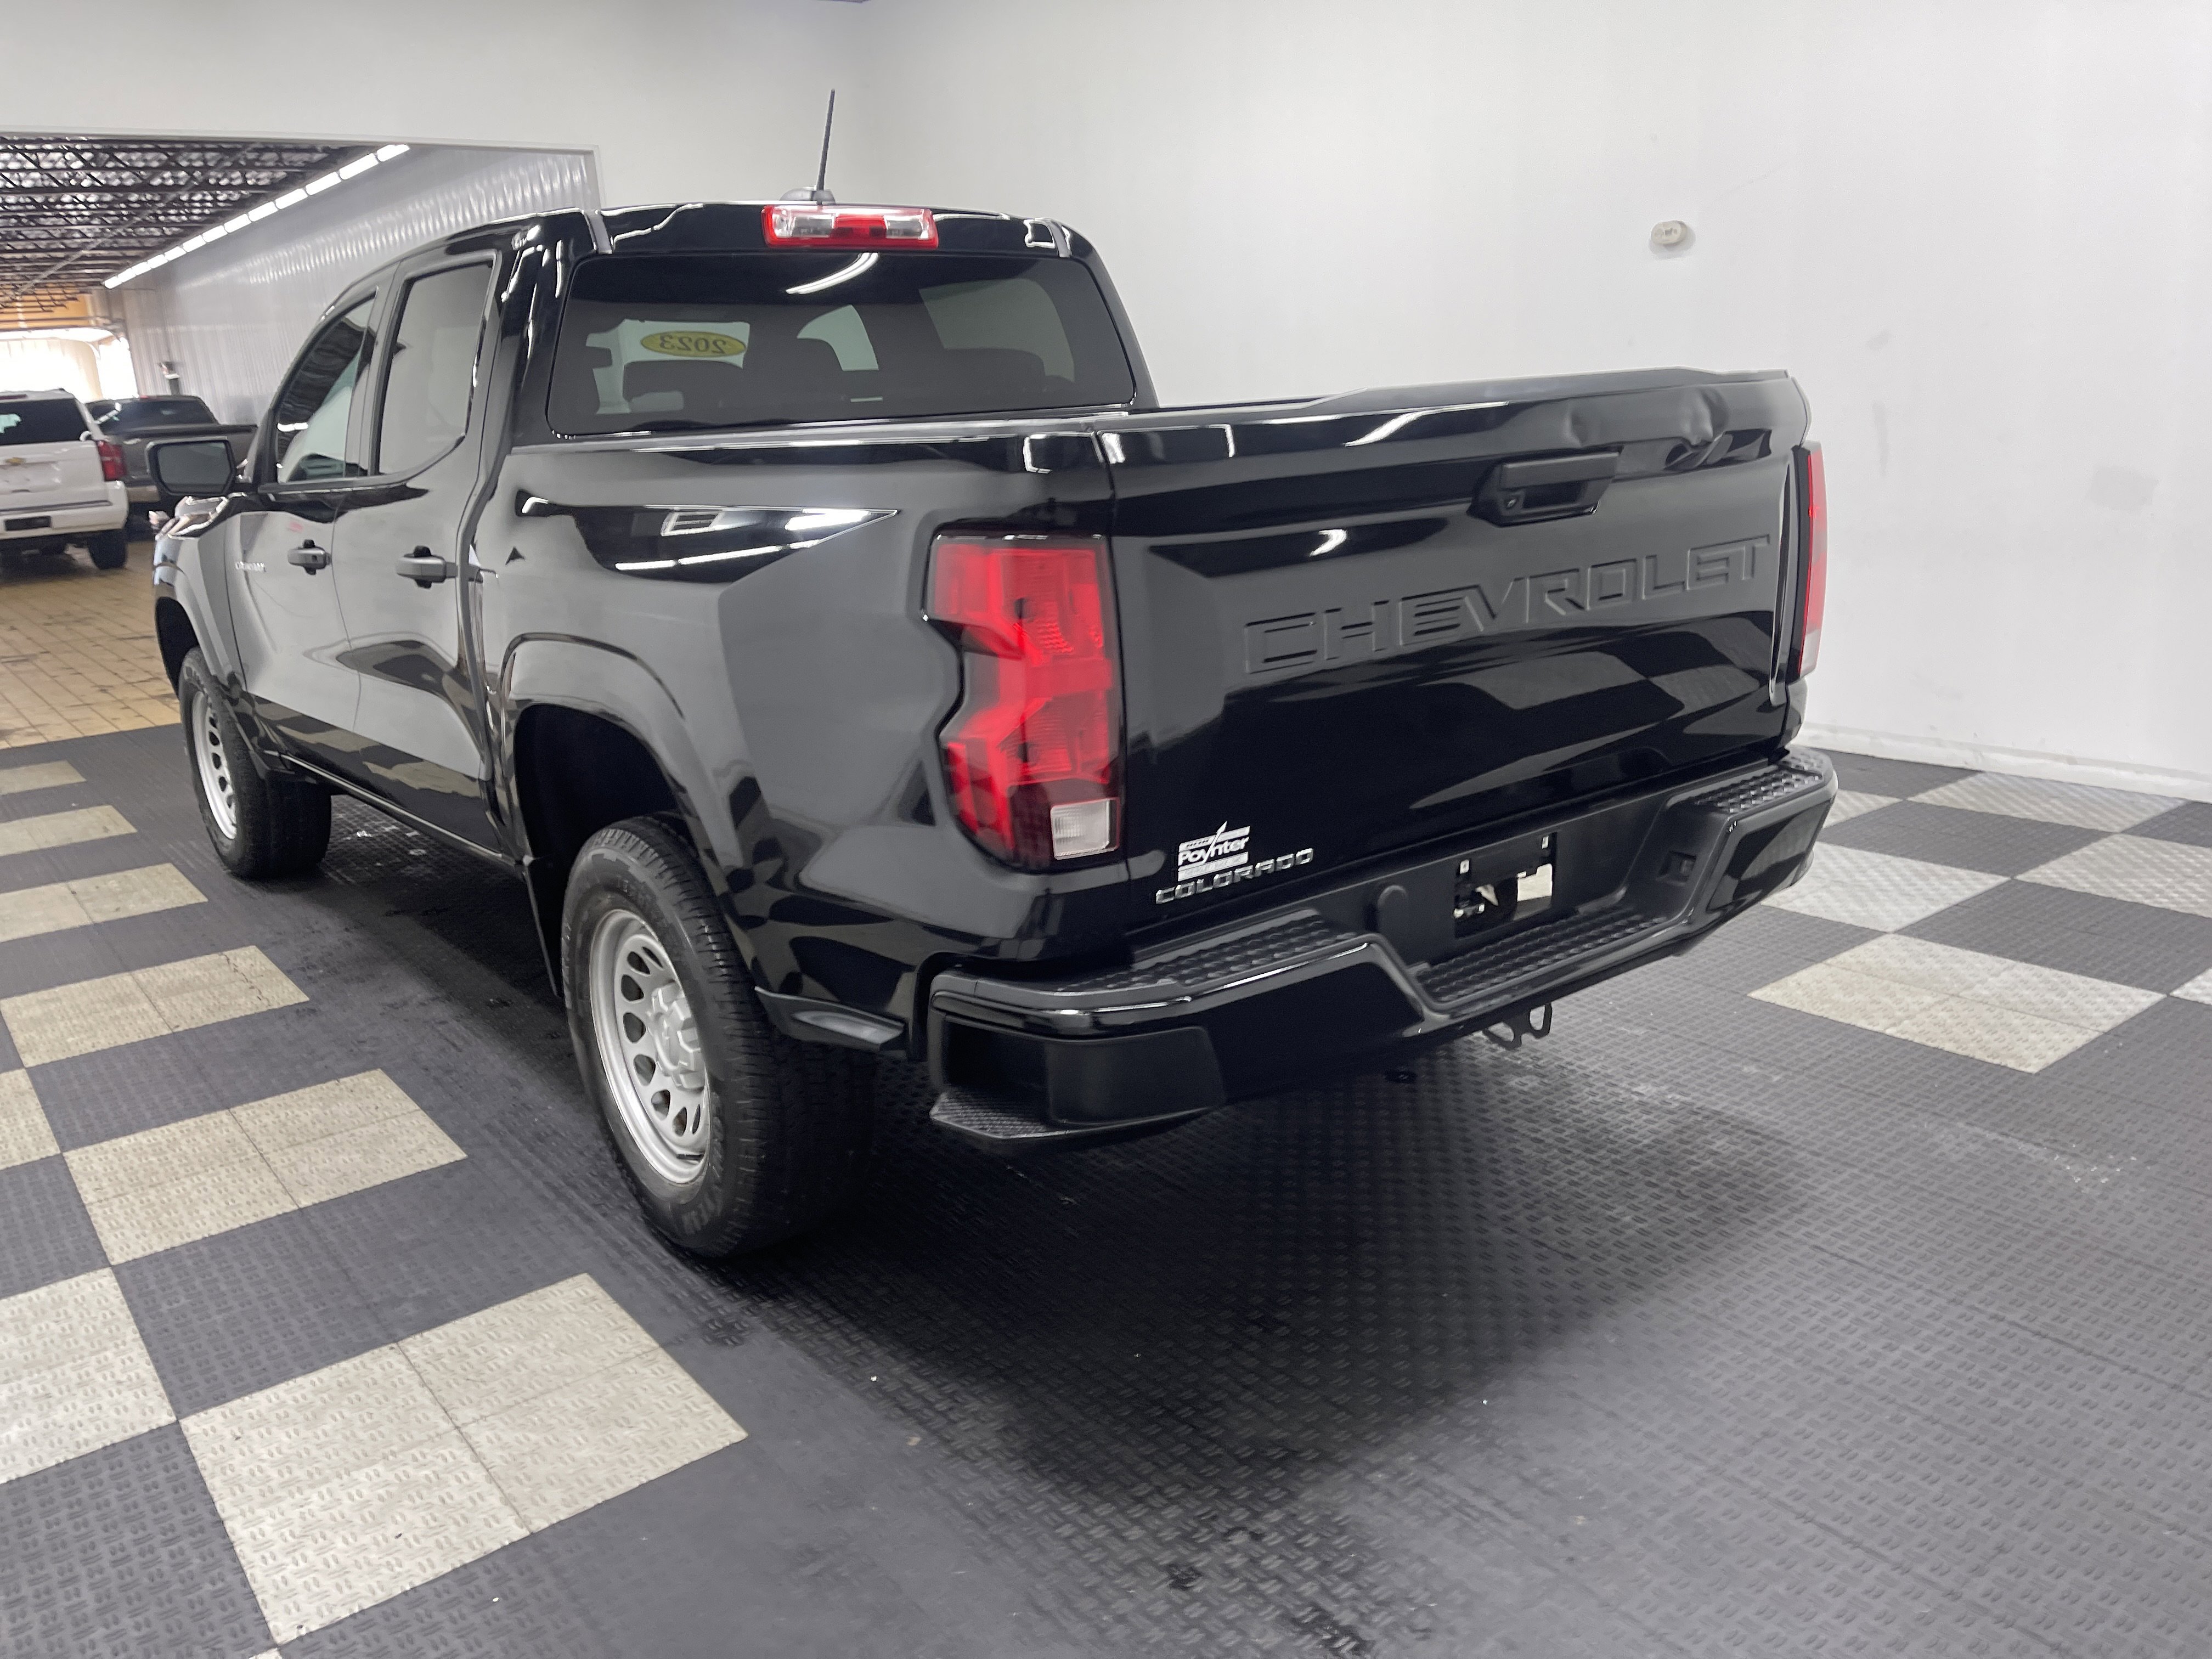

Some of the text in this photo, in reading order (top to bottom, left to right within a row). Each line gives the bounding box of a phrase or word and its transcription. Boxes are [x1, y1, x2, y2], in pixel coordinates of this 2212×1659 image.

[1243, 533, 1771, 673] CHEVROLET
[1155, 848, 1314, 904] COLORADO
[1178, 831, 1249, 866] Poynter
